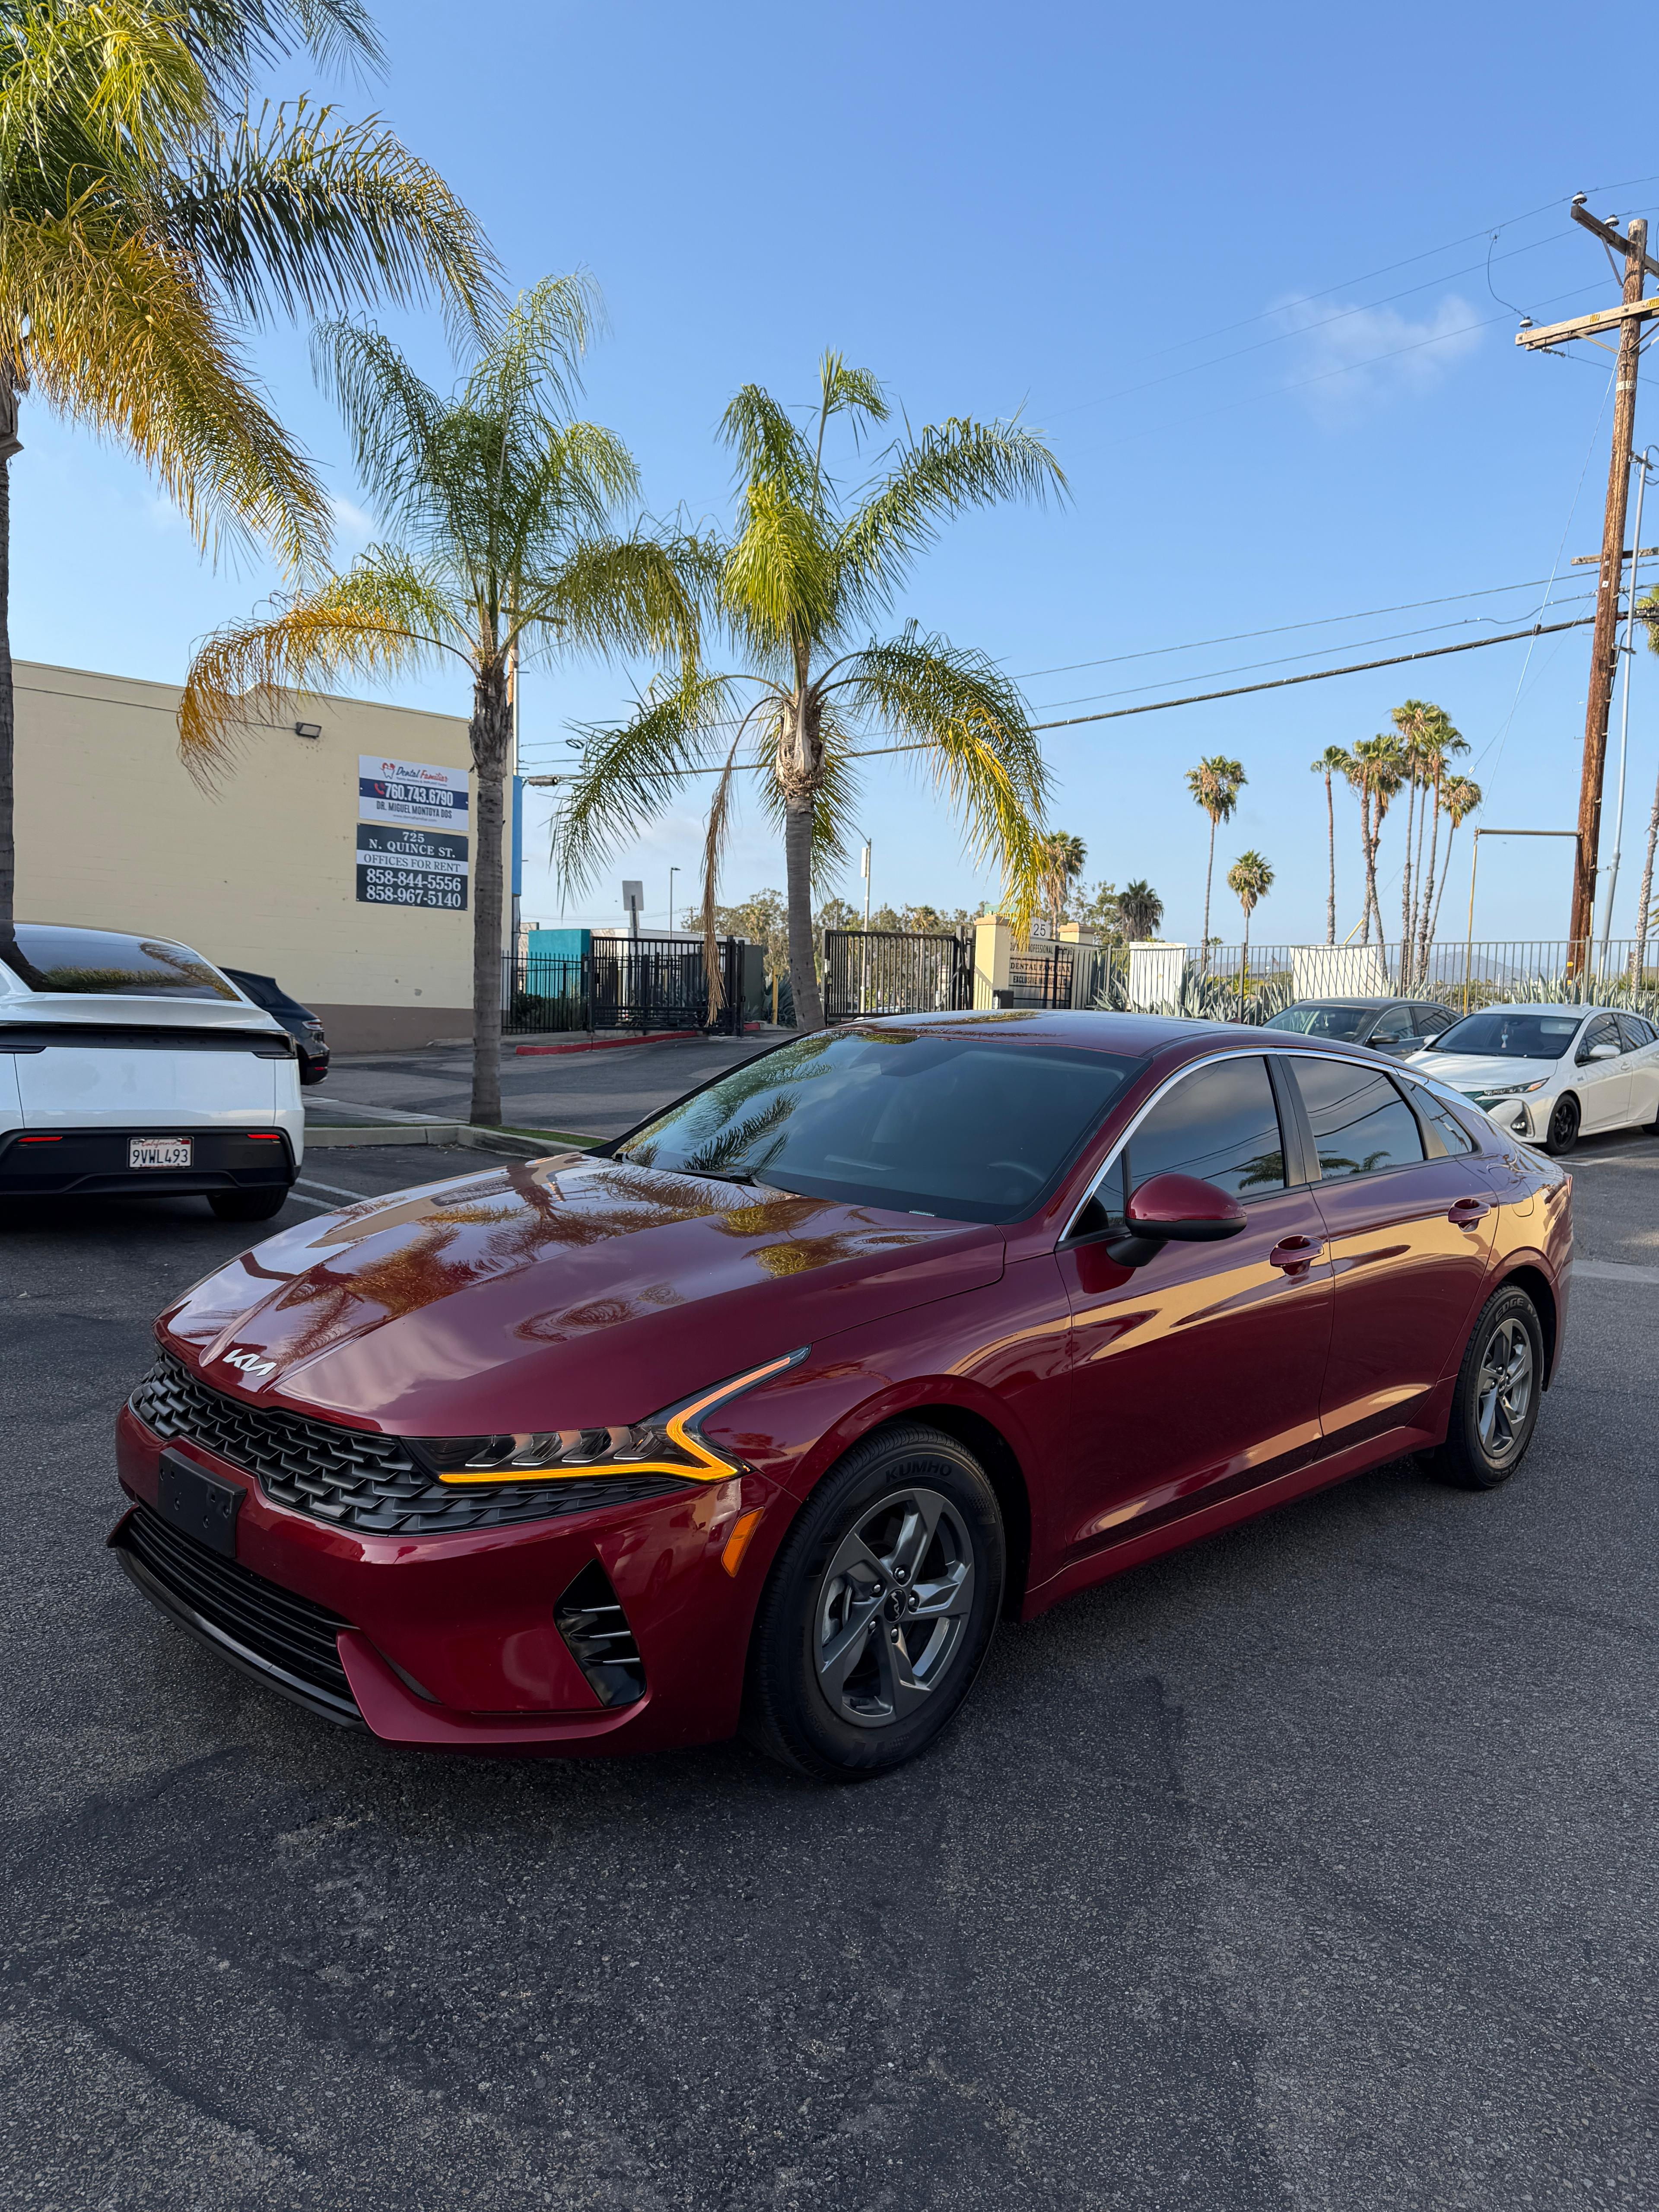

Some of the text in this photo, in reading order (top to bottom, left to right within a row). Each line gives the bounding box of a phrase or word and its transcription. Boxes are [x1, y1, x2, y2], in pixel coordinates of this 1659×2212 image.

[396, 766, 448, 782] Dental Familiar
[385, 783, 453, 807] 760.743.6790
[376, 801, 452, 819] DR. MIGUEL MONTOYA DDS
[402, 831, 425, 843] 725
[369, 839, 456, 858] N. QUINCE ST.
[364, 854, 461, 873] OFFICES FOR RENT
[366, 868, 461, 891] 858-844-5556
[366, 885, 461, 907] 858-967-5140
[1028, 923, 1046, 937] 25
[1010, 962, 1037, 970] DENTAL
[1013, 975, 1037, 985] EXCLUSIVE
[132, 1149, 188, 1164] 9VWL493
[1495, 1297, 1524, 1322] EDGE
[886, 1459, 952, 1483] KUMHO
